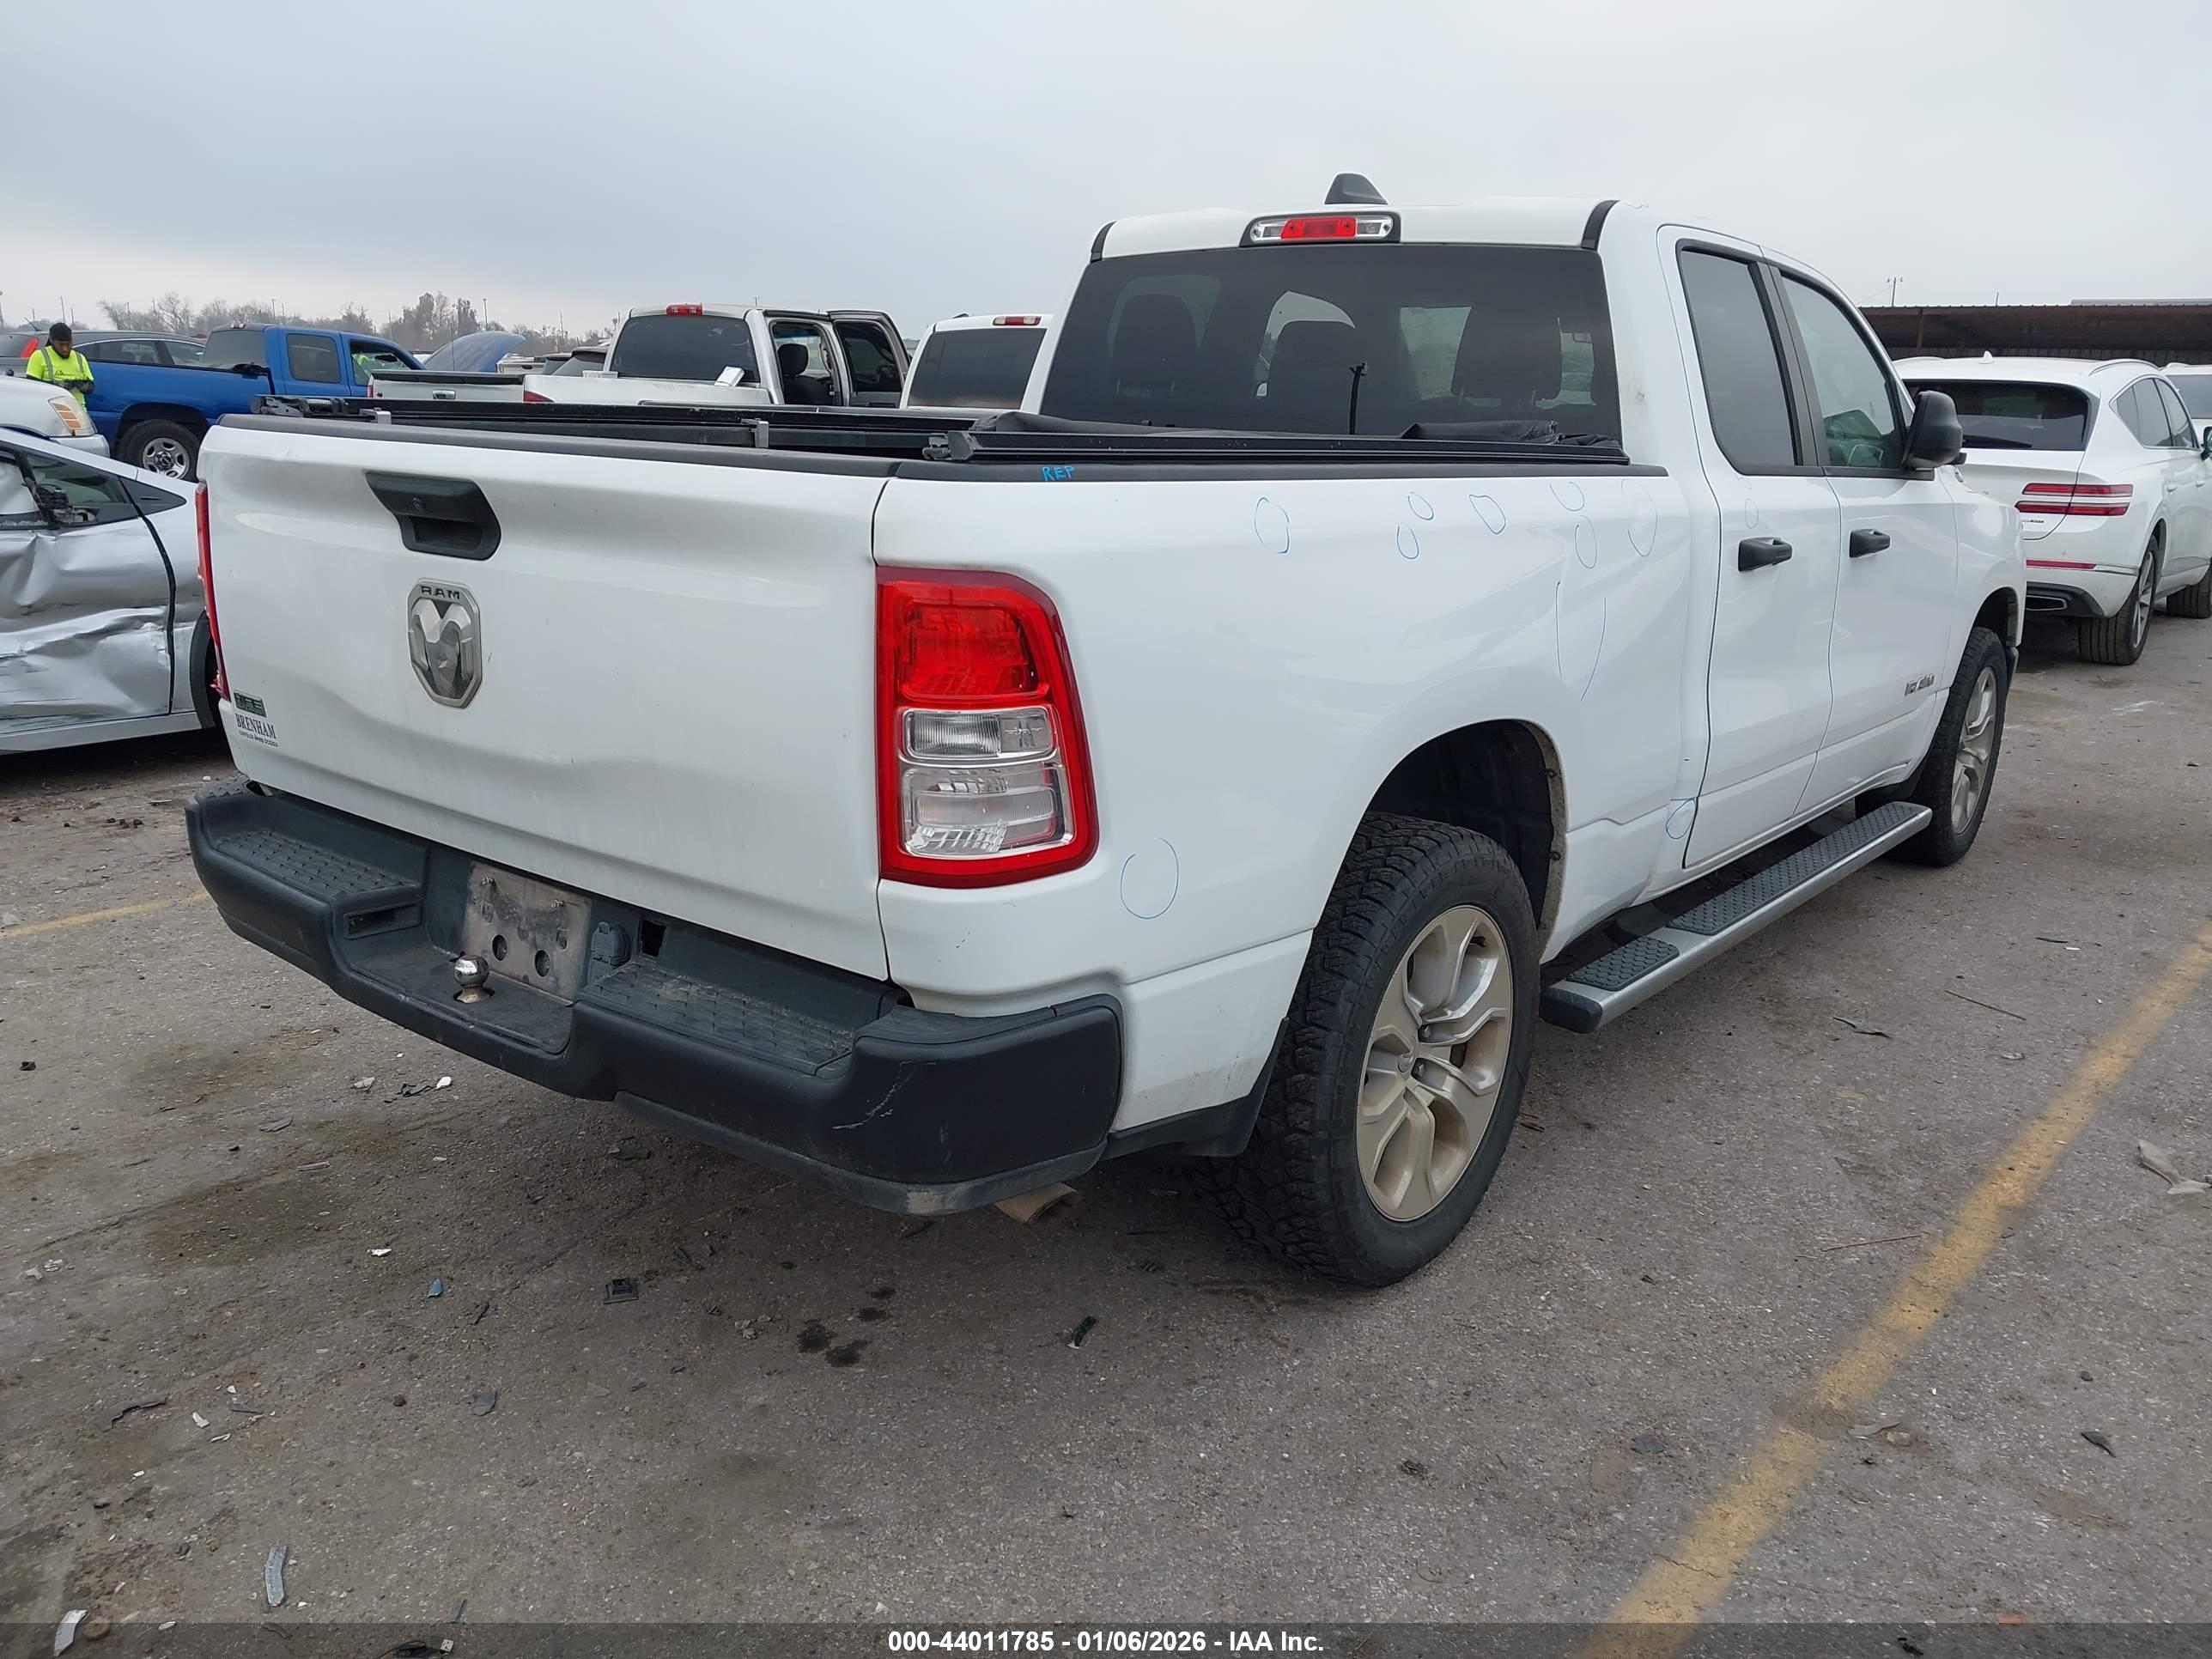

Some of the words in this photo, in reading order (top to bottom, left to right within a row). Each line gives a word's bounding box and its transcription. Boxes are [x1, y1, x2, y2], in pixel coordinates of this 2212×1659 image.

[1042, 466, 1075, 481] REP
[420, 586, 460, 600] RAM
[234, 713, 276, 739] BRENHAM
